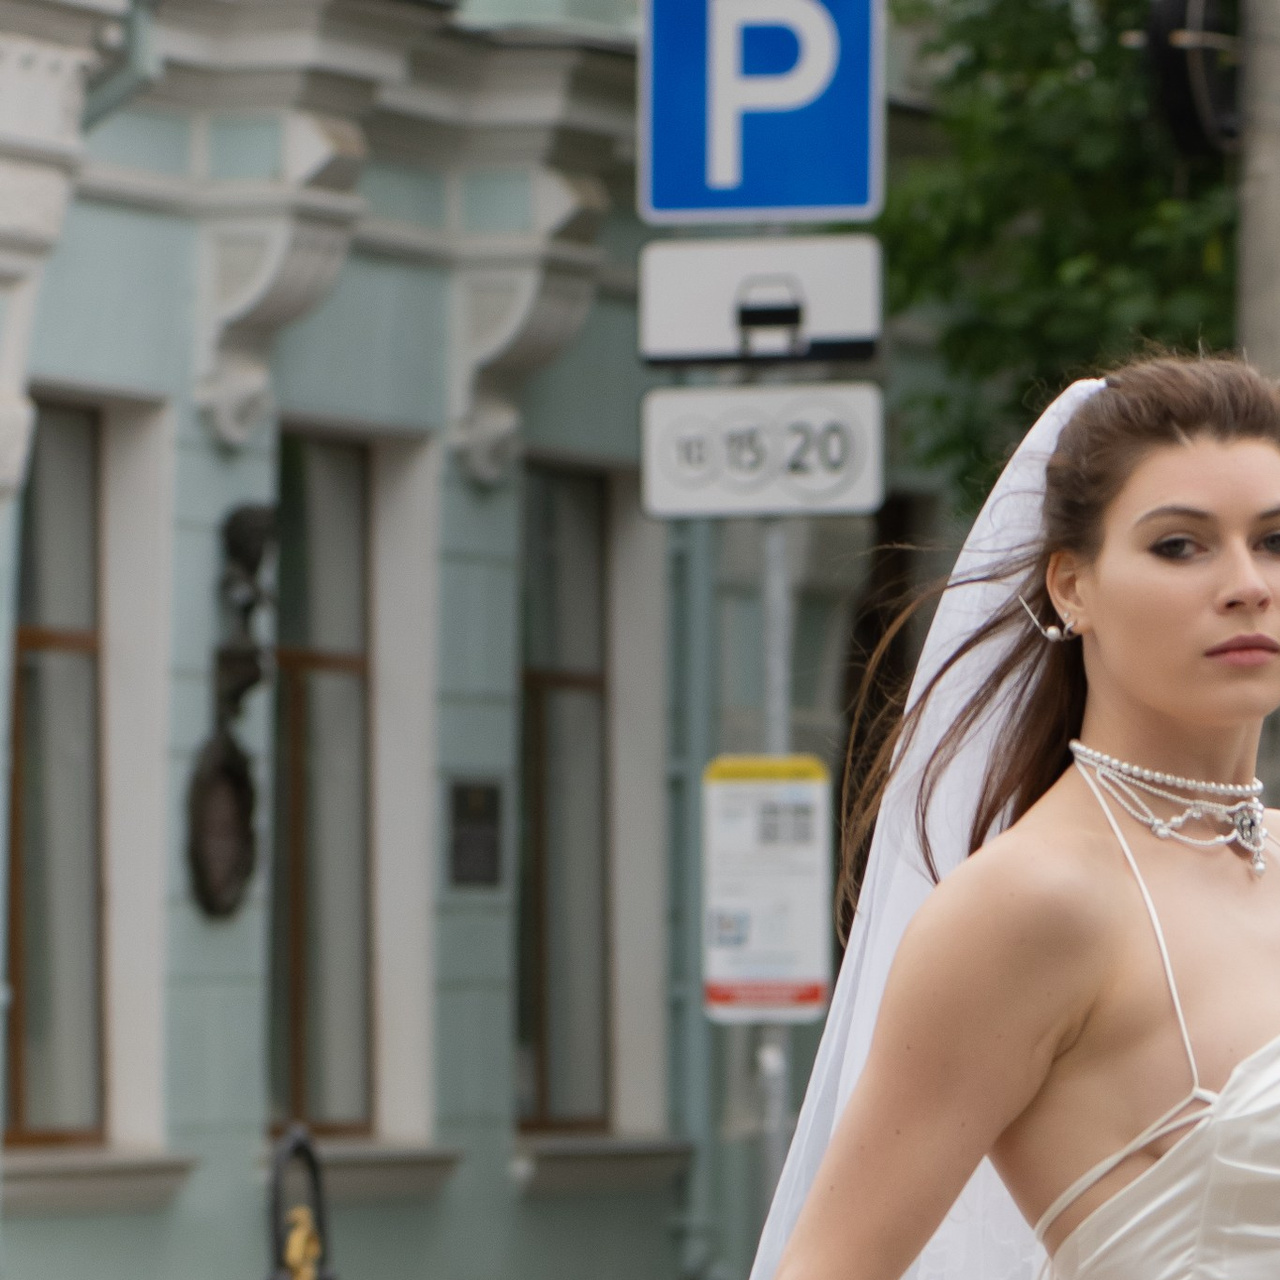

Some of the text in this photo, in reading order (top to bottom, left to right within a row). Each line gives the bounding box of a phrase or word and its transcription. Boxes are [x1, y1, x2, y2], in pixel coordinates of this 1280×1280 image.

[705, 0, 840, 190] P
[723, 428, 767, 472] 15
[785, 422, 852, 474] 20
